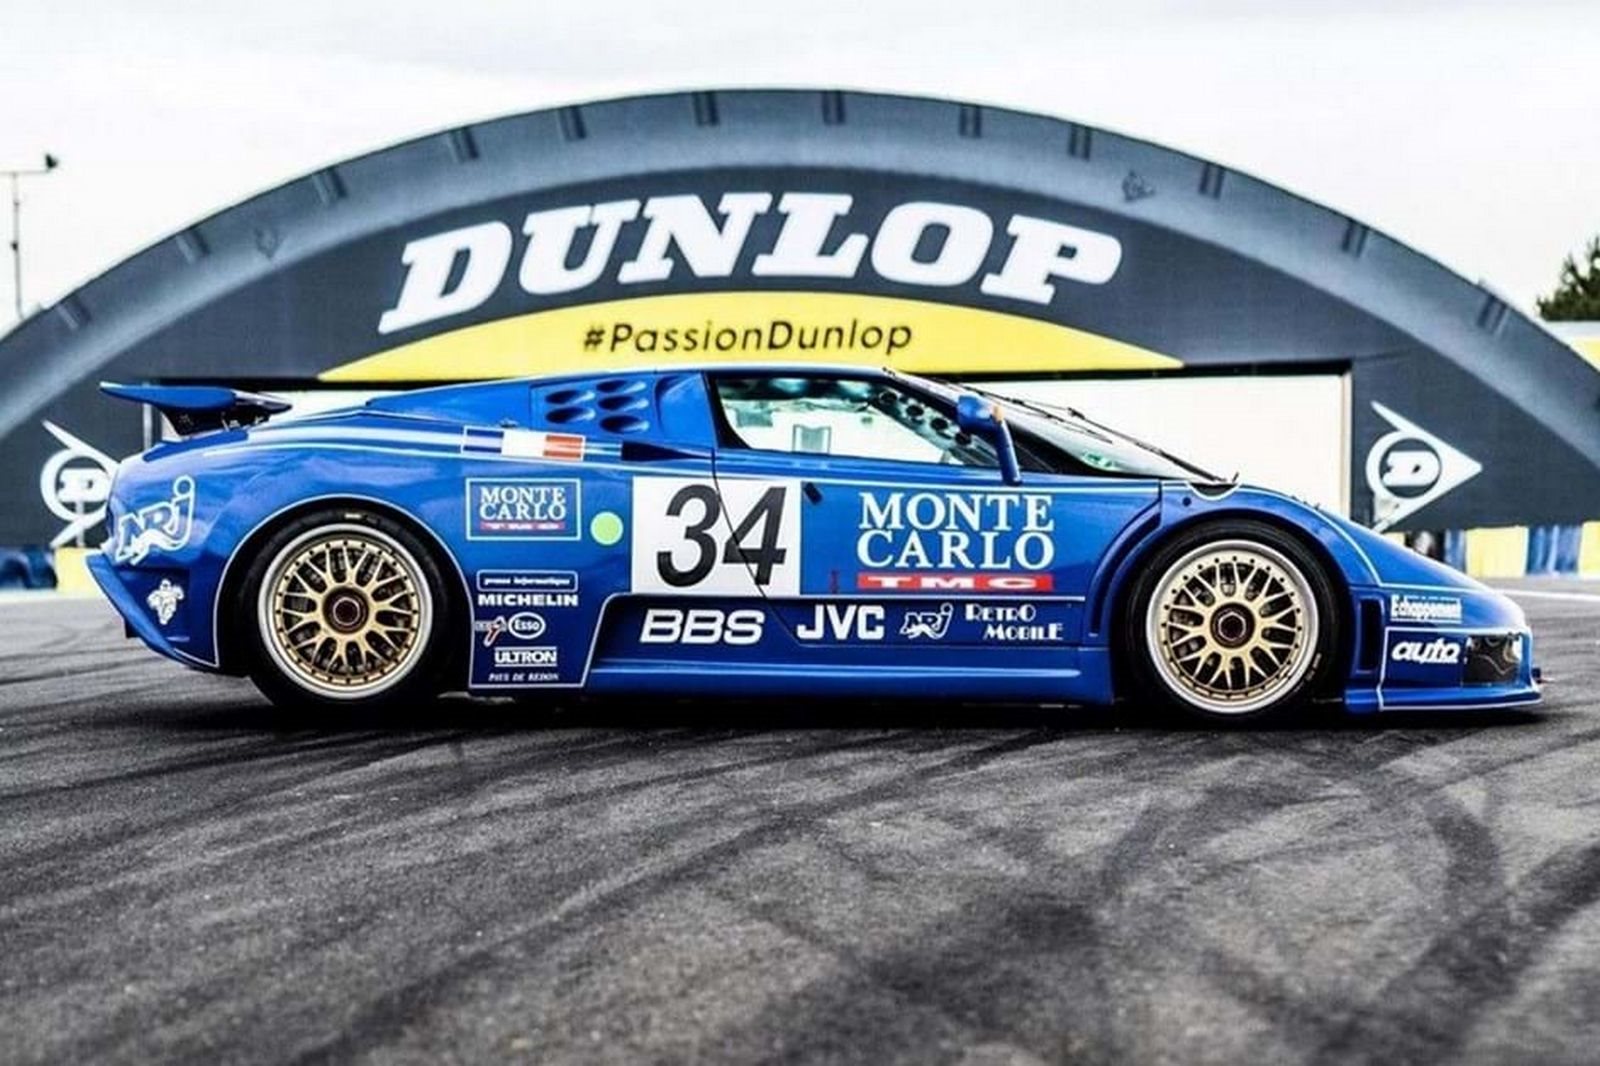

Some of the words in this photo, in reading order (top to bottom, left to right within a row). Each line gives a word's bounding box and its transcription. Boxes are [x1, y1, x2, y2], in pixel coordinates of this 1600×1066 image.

[377, 192, 1123, 335] DUNLOP
[583, 318, 912, 355] #PassionDunlop
[480, 486, 566, 504] MONTE
[479, 502, 566, 520] CARLO
[858, 492, 1055, 532] MONTE
[656, 484, 787, 588] 34
[856, 529, 1055, 570] CARLO
[867, 575, 1037, 589] TMC
[478, 594, 579, 606] MICHELIN
[514, 619, 540, 631] Esso
[639, 608, 766, 645] BBS
[796, 604, 885, 640] JVC
[494, 651, 557, 664] ULTRON
[1391, 637, 1461, 664] auto
